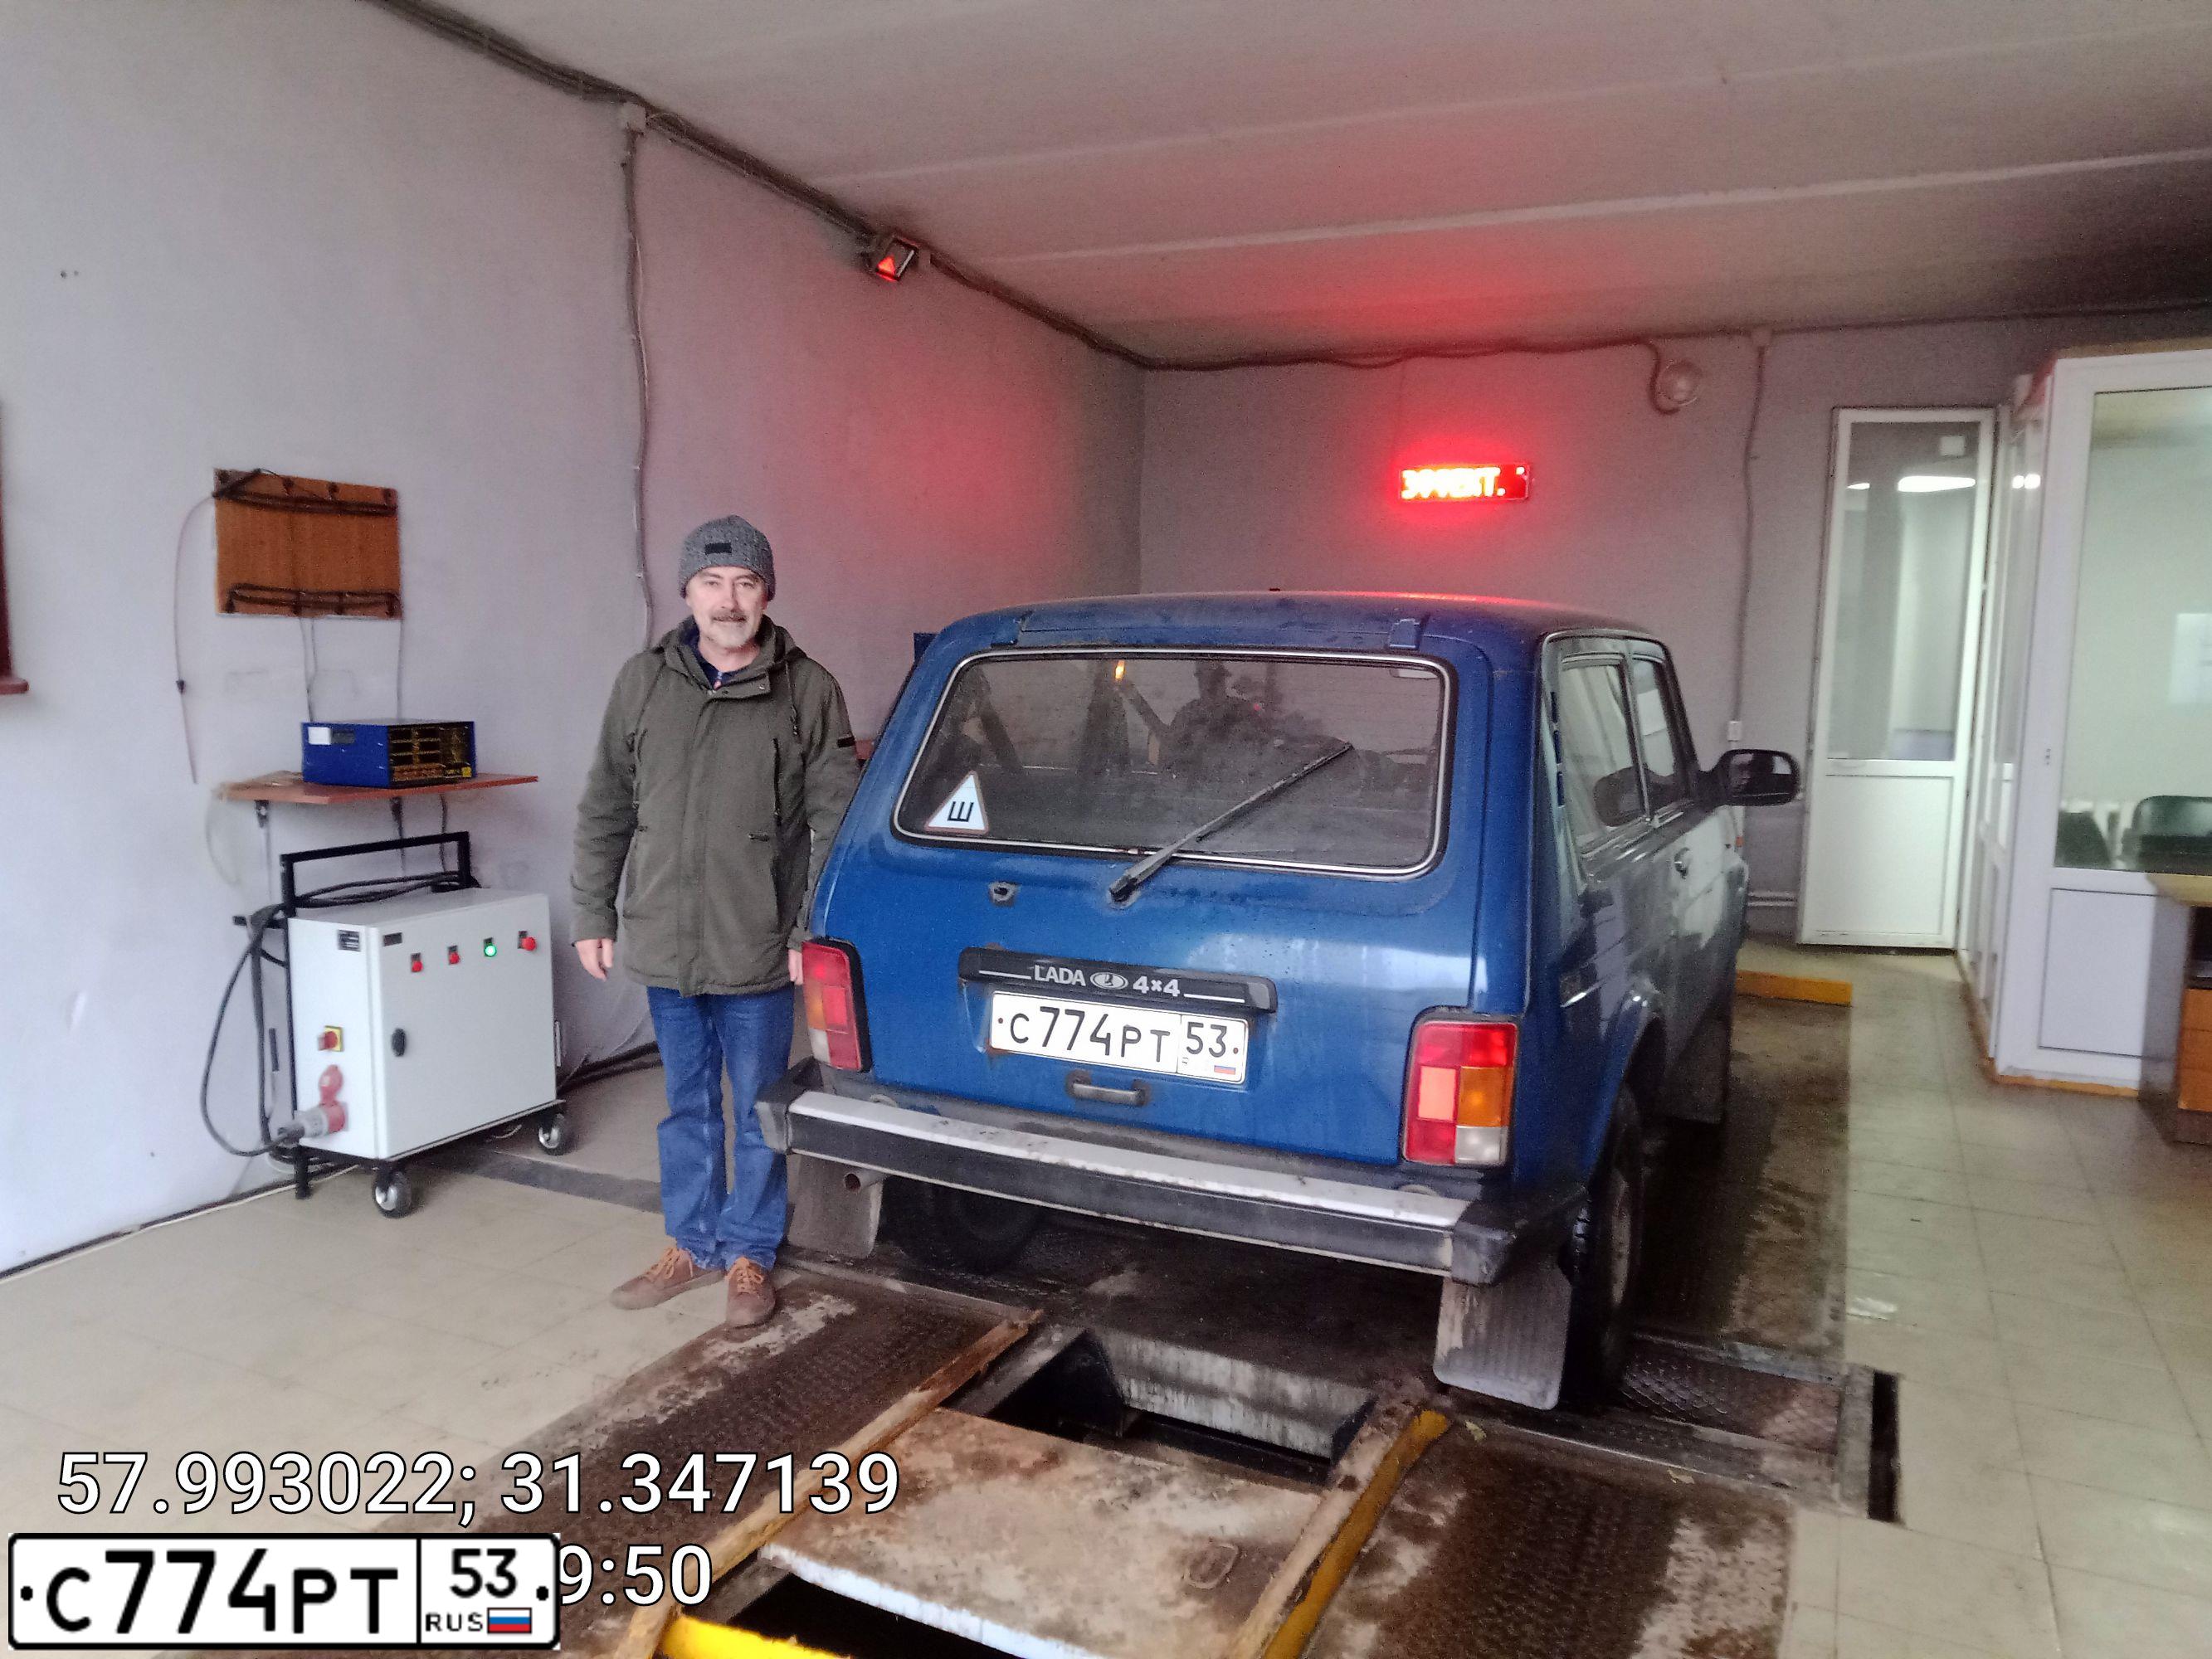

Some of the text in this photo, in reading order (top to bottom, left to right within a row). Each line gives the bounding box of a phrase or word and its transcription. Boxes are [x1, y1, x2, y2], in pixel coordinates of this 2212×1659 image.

[947, 800, 974, 822] Ш
[1034, 964, 1086, 987] LADA
[1186, 1021, 1227, 1058] 53
